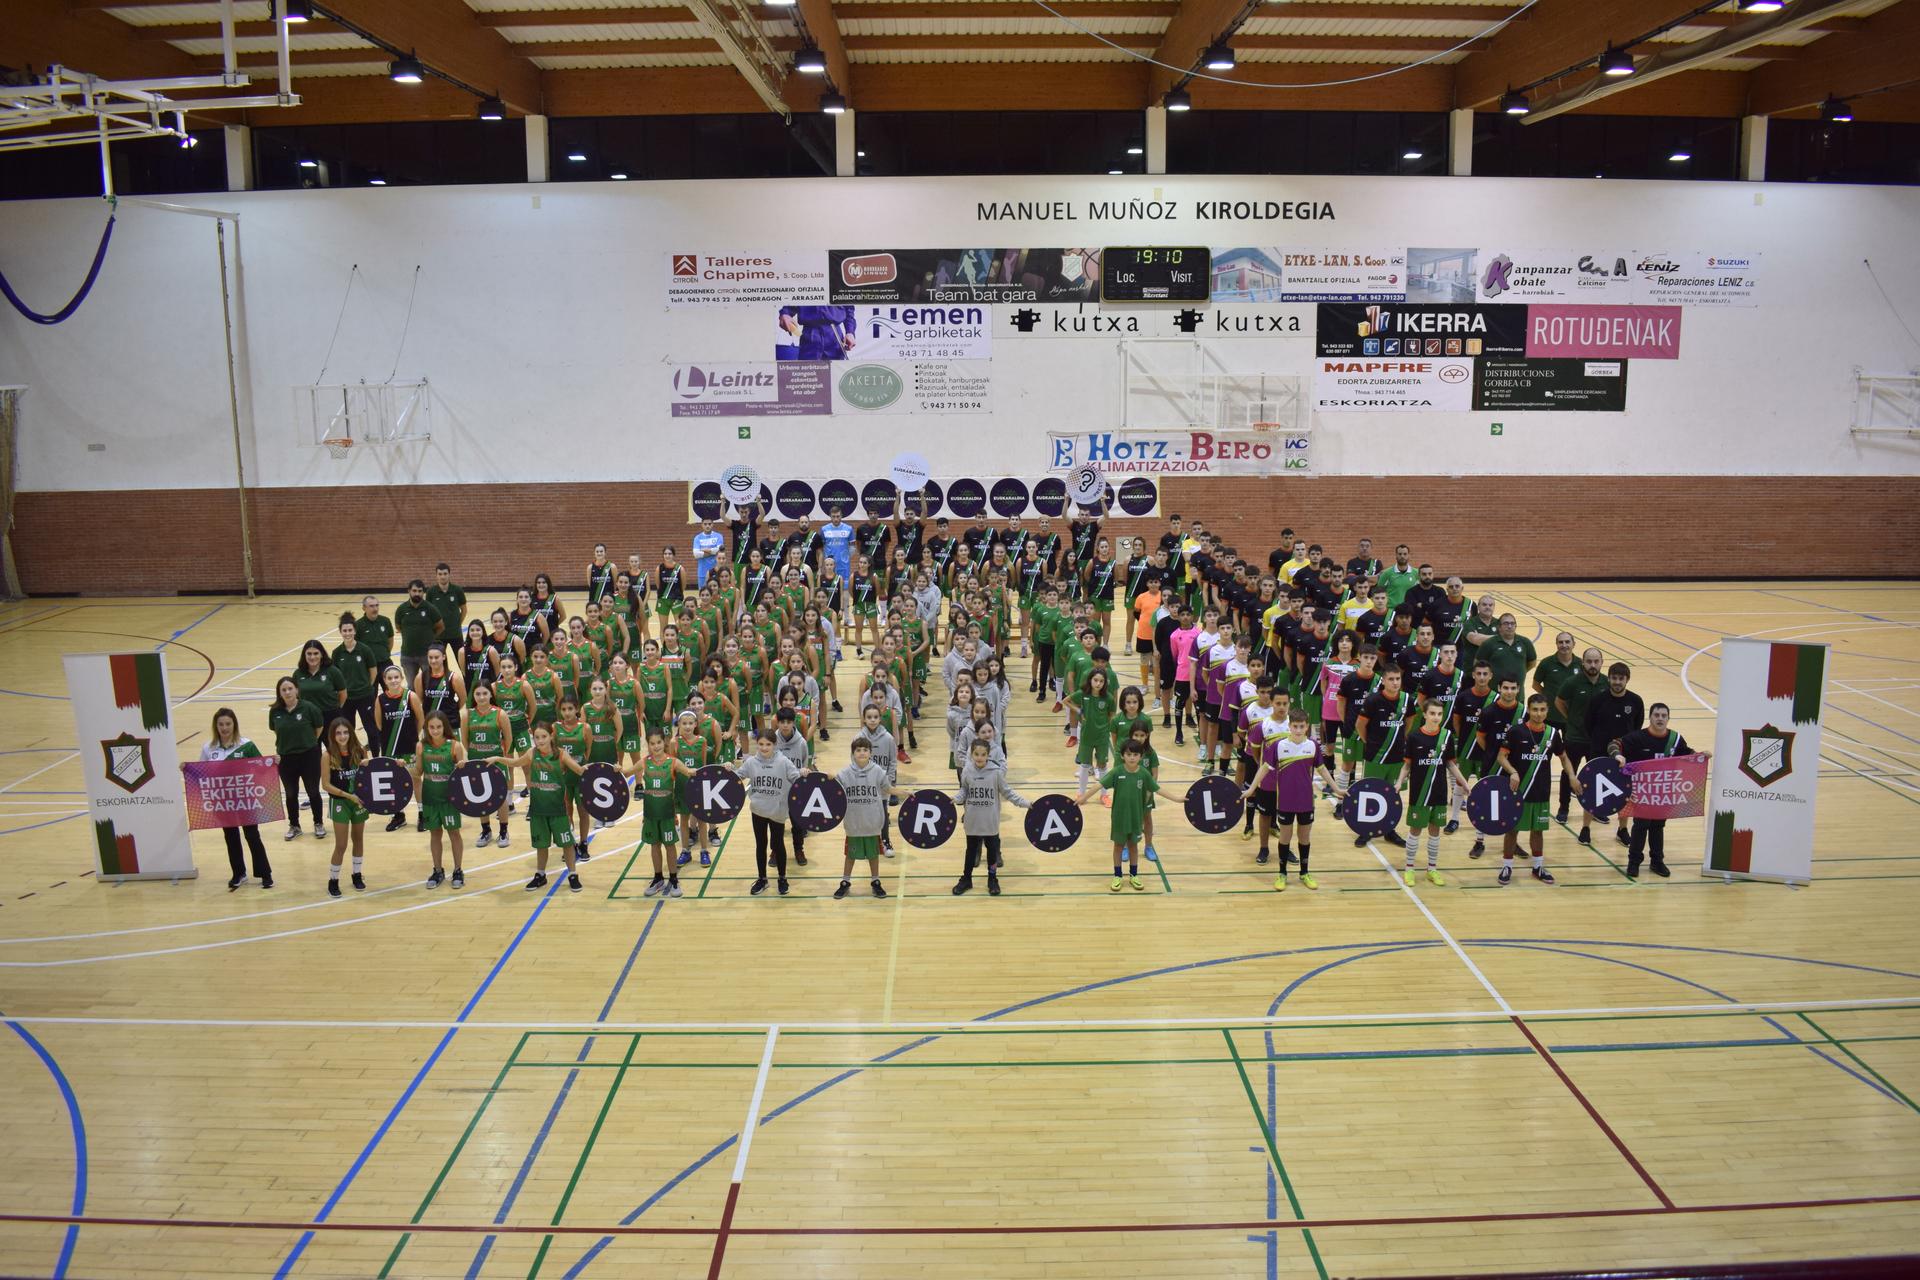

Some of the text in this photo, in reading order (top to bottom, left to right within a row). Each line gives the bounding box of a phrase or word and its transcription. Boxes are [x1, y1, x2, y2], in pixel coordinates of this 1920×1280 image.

[977, 198, 1336, 221] MANUEL MUÑOZ KIROLDEGIA
[704, 256, 773, 267] Talleres
[1135, 249, 1182, 264] 19:10
[703, 269, 780, 282] Chapime,
[1657, 275, 1743, 287] Reparaciones LENIZ
[926, 288, 969, 301] Team
[973, 288, 998, 301] bat
[1002, 290, 1036, 304] gara
[1055, 309, 1139, 333] kutxa
[1217, 309, 1301, 333] kutxa
[1396, 313, 1487, 333] IKERRA
[904, 326, 982, 341] garbiketak
[1533, 317, 1673, 347] ROTUDENAK
[1324, 362, 1432, 373] MAPFRE
[1485, 369, 1555, 378] DISTRIBUCIONES
[707, 371, 775, 387] Leintz
[848, 375, 894, 386] AKEITA
[948, 377, 990, 385] hanburgesak
[1484, 379, 1532, 387] GORBEA CB
[893, 466, 926, 477] EUSKARALDIA
[595, 724, 600, 733] 8
[475, 732, 487, 742] 20
[517, 738, 527, 747] 23
[431, 763, 439, 772] 14
[685, 758, 694, 767] 20
[199, 774, 255, 789] HITZEZ
[539, 771, 548, 781] 16
[1631, 769, 1683, 783] HITZEZ
[653, 778, 661, 788] 18
[1631, 780, 1694, 795] EKITEKO
[201, 786, 266, 801] EKITEKO
[1722, 788, 1781, 801] ESKORIATZA
[96, 796, 153, 807] ESKORIATZA
[203, 799, 263, 812] GARAIA
[371, 771, 1624, 841] E U S K A R A L D I A
[1630, 794, 1688, 806] GARAIA
[445, 815, 455, 826] 14
[560, 832, 570, 843] 16
[664, 831, 673, 842] 18
